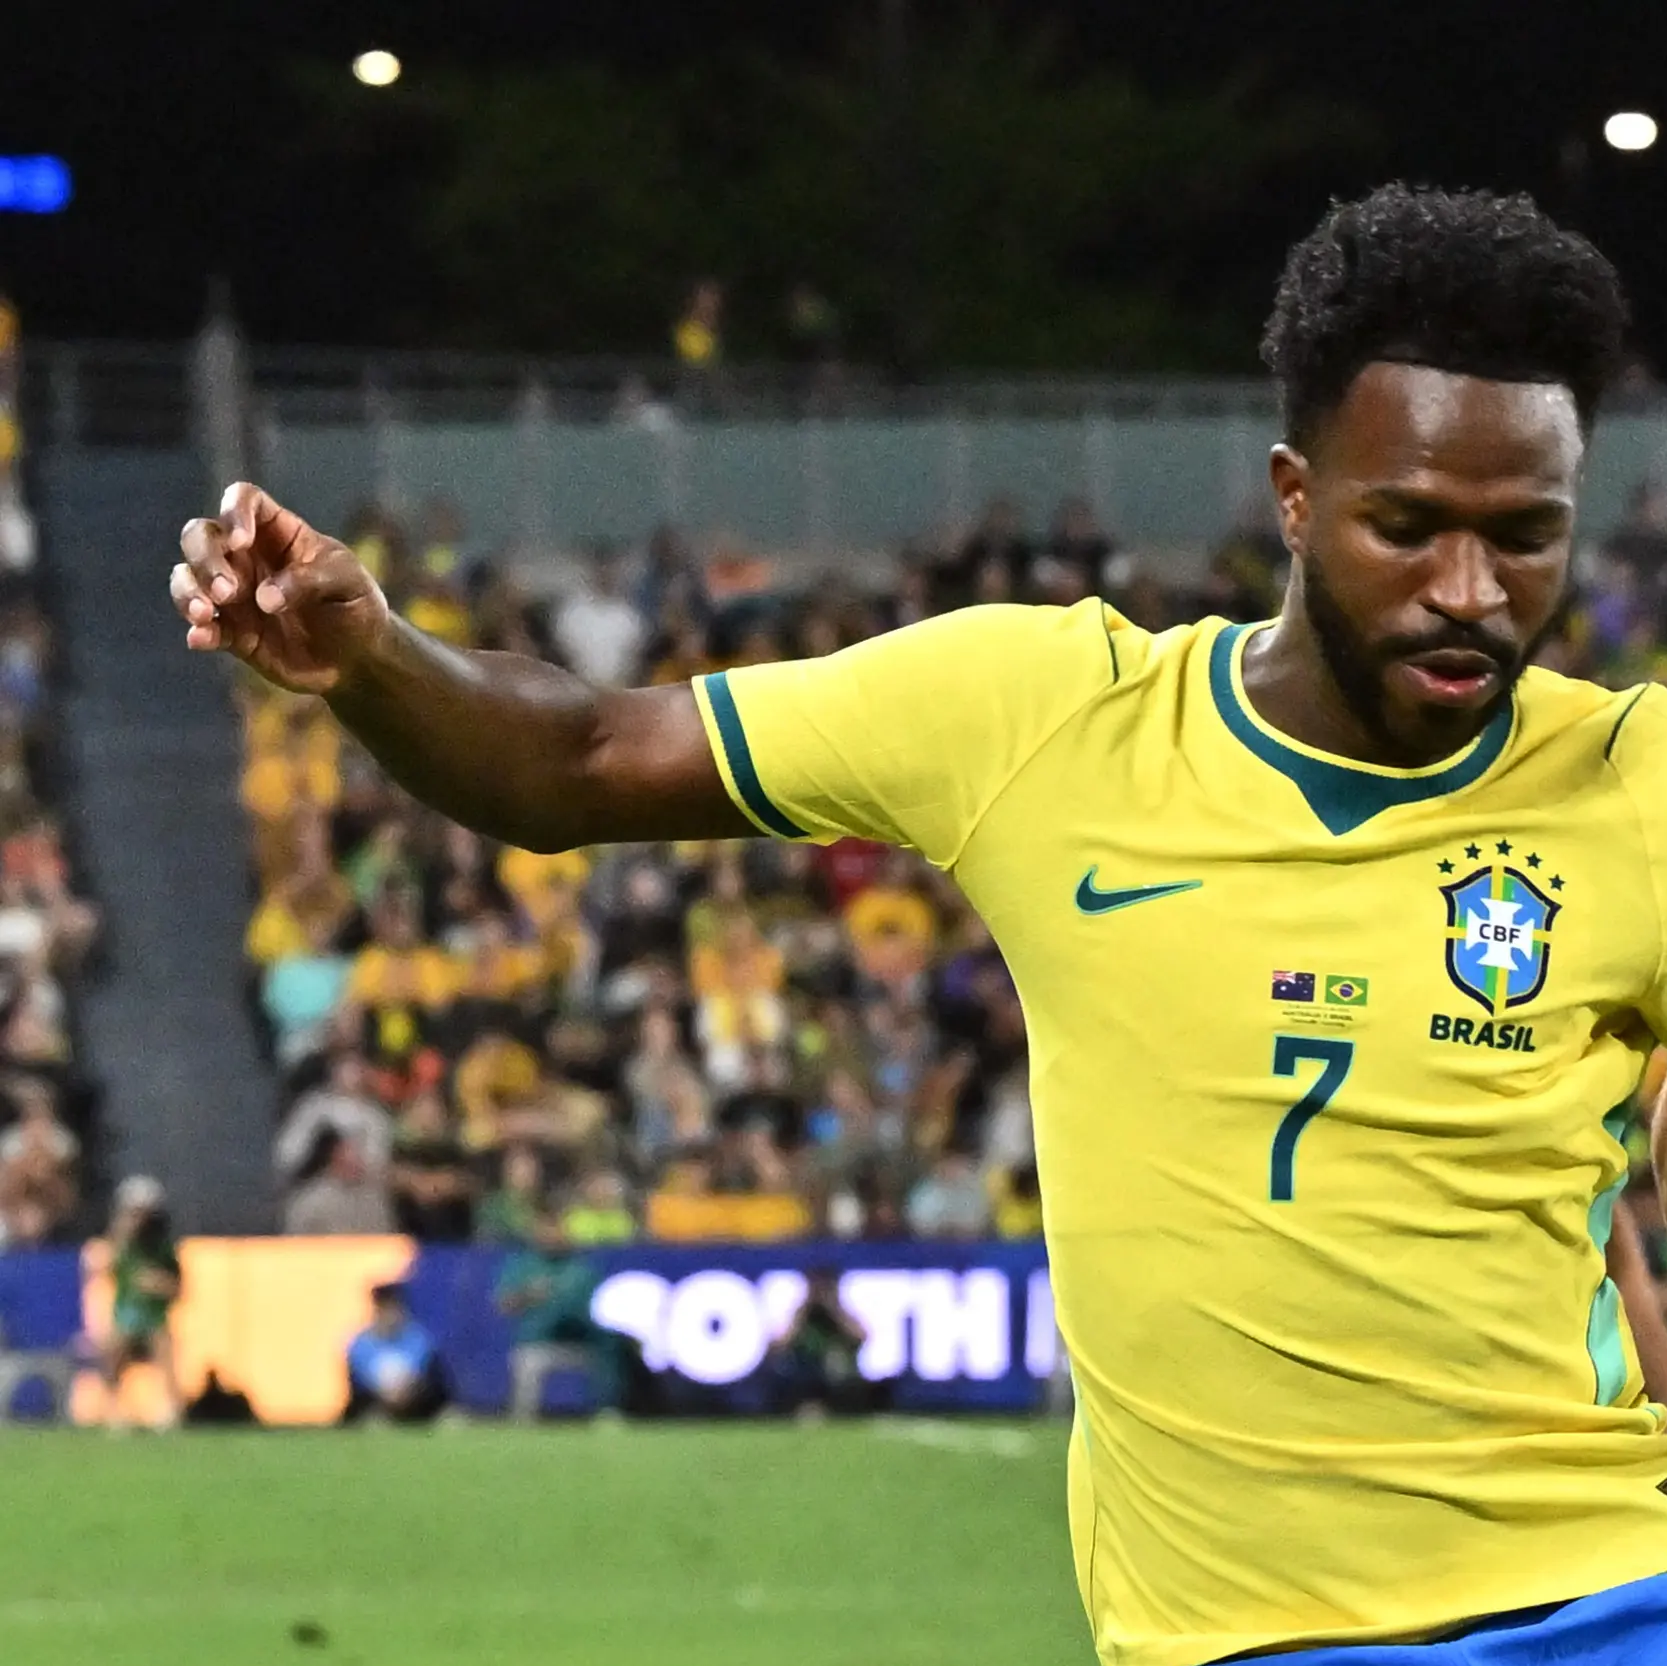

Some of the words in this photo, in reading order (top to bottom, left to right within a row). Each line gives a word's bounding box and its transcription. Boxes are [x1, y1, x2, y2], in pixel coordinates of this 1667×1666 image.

[1479, 923, 1521, 943] CBF
[1430, 1013, 1536, 1053] BRASIL
[1269, 1034, 1356, 1204] 7
